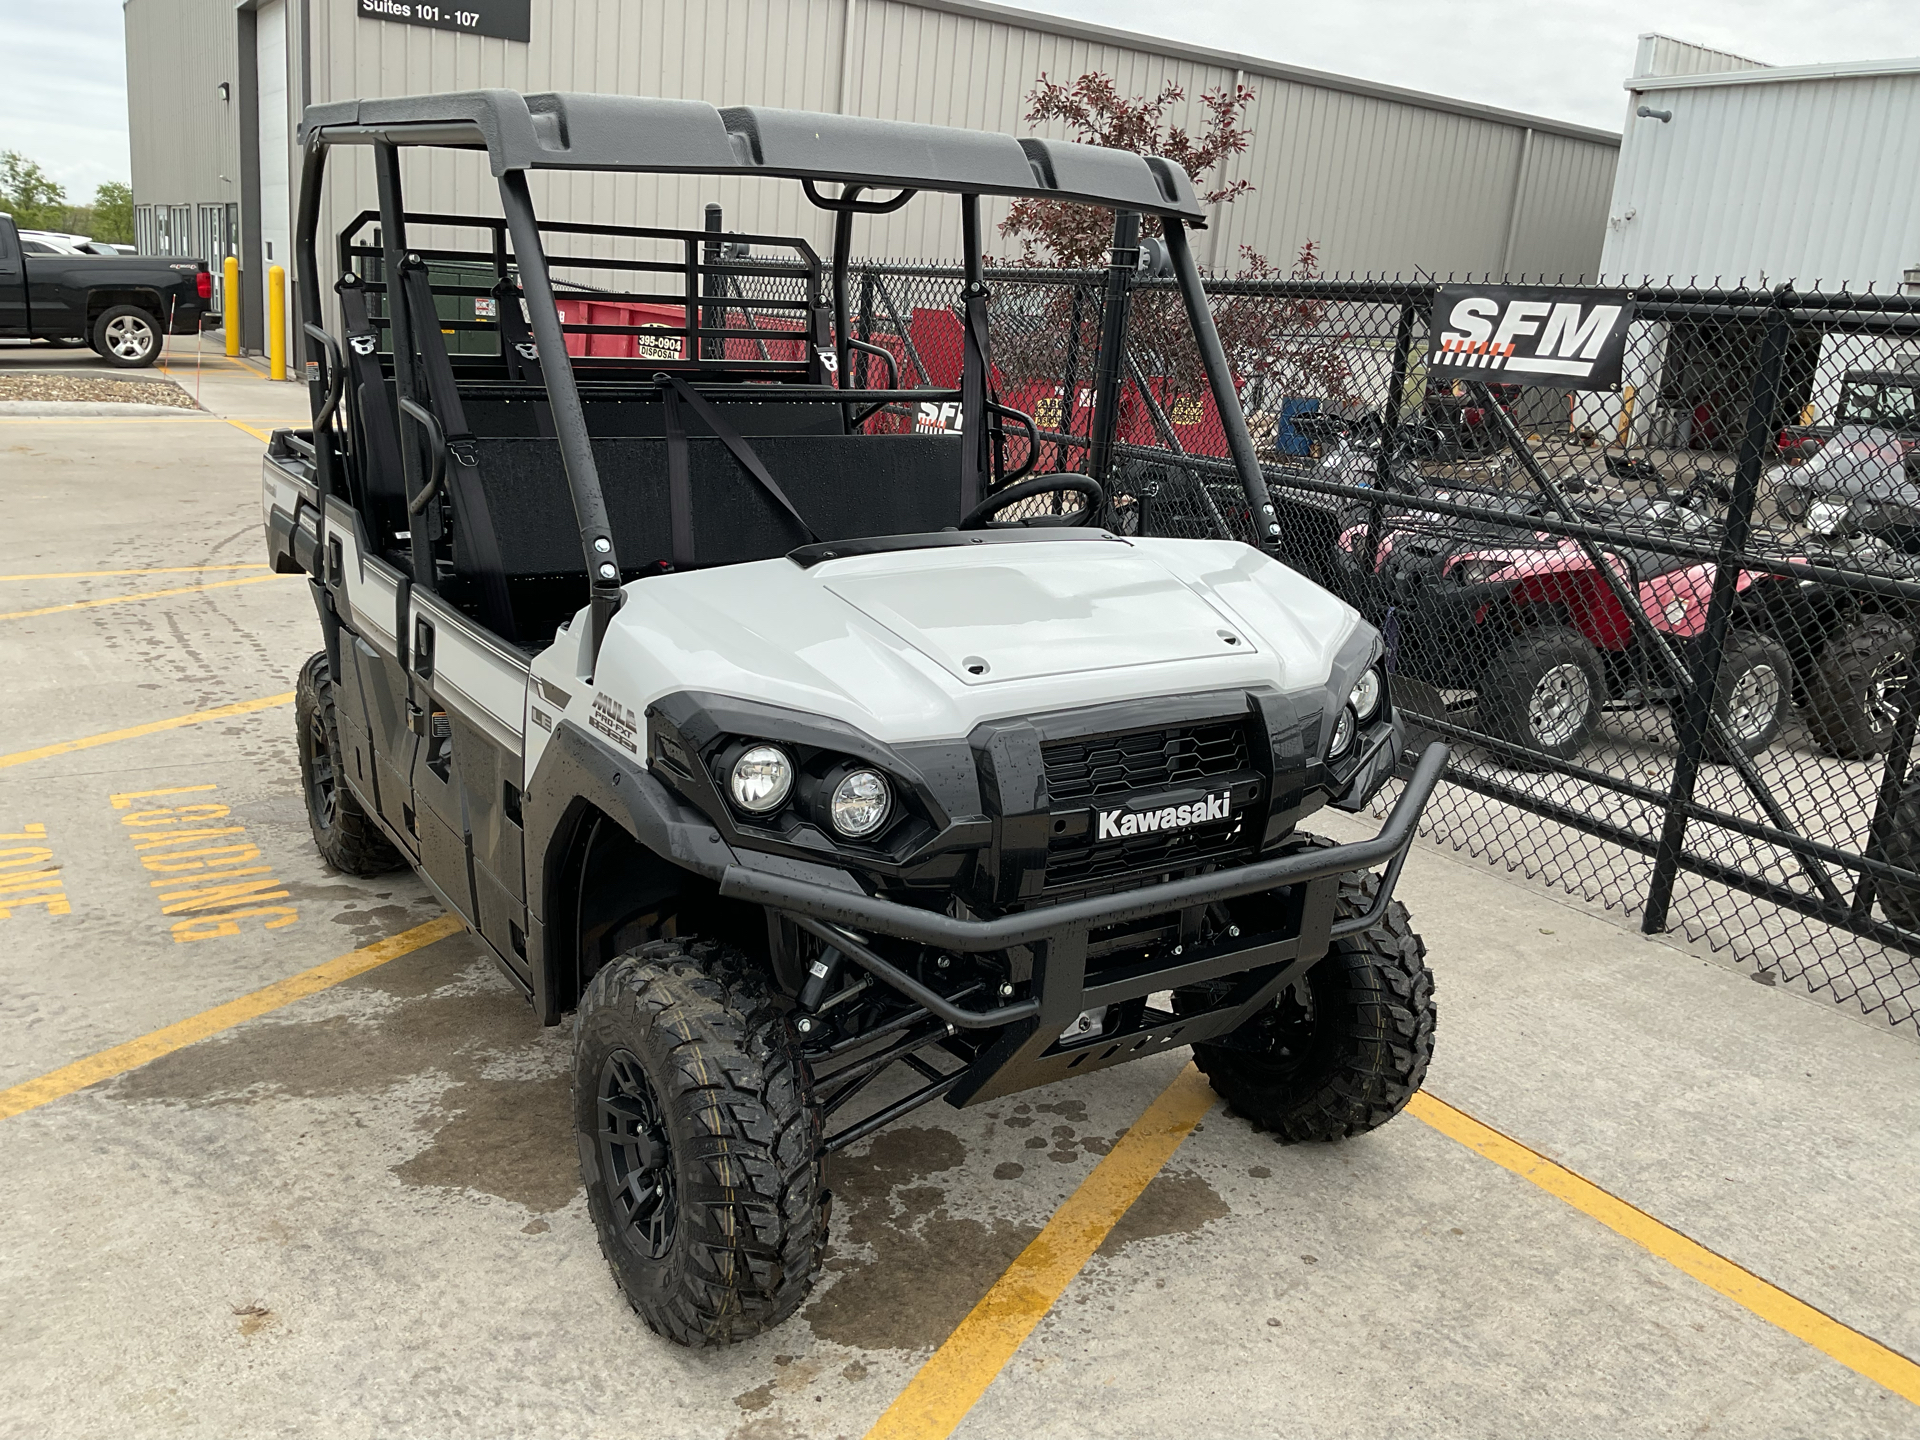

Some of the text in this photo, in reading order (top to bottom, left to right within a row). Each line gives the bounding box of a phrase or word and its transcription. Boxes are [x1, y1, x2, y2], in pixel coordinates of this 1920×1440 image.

[363, 0, 411, 17] Suites
[416, 4, 439, 21] 101
[455, 11, 480, 27] 107
[638, 334, 681, 351] 395-0904
[1438, 297, 1622, 360] SFM
[641, 346, 677, 360] DISPOSAL
[532, 706, 552, 732] LE
[591, 691, 637, 734] MULE
[1098, 791, 1230, 839] Kawasaki
[109, 783, 299, 943] LOADING
